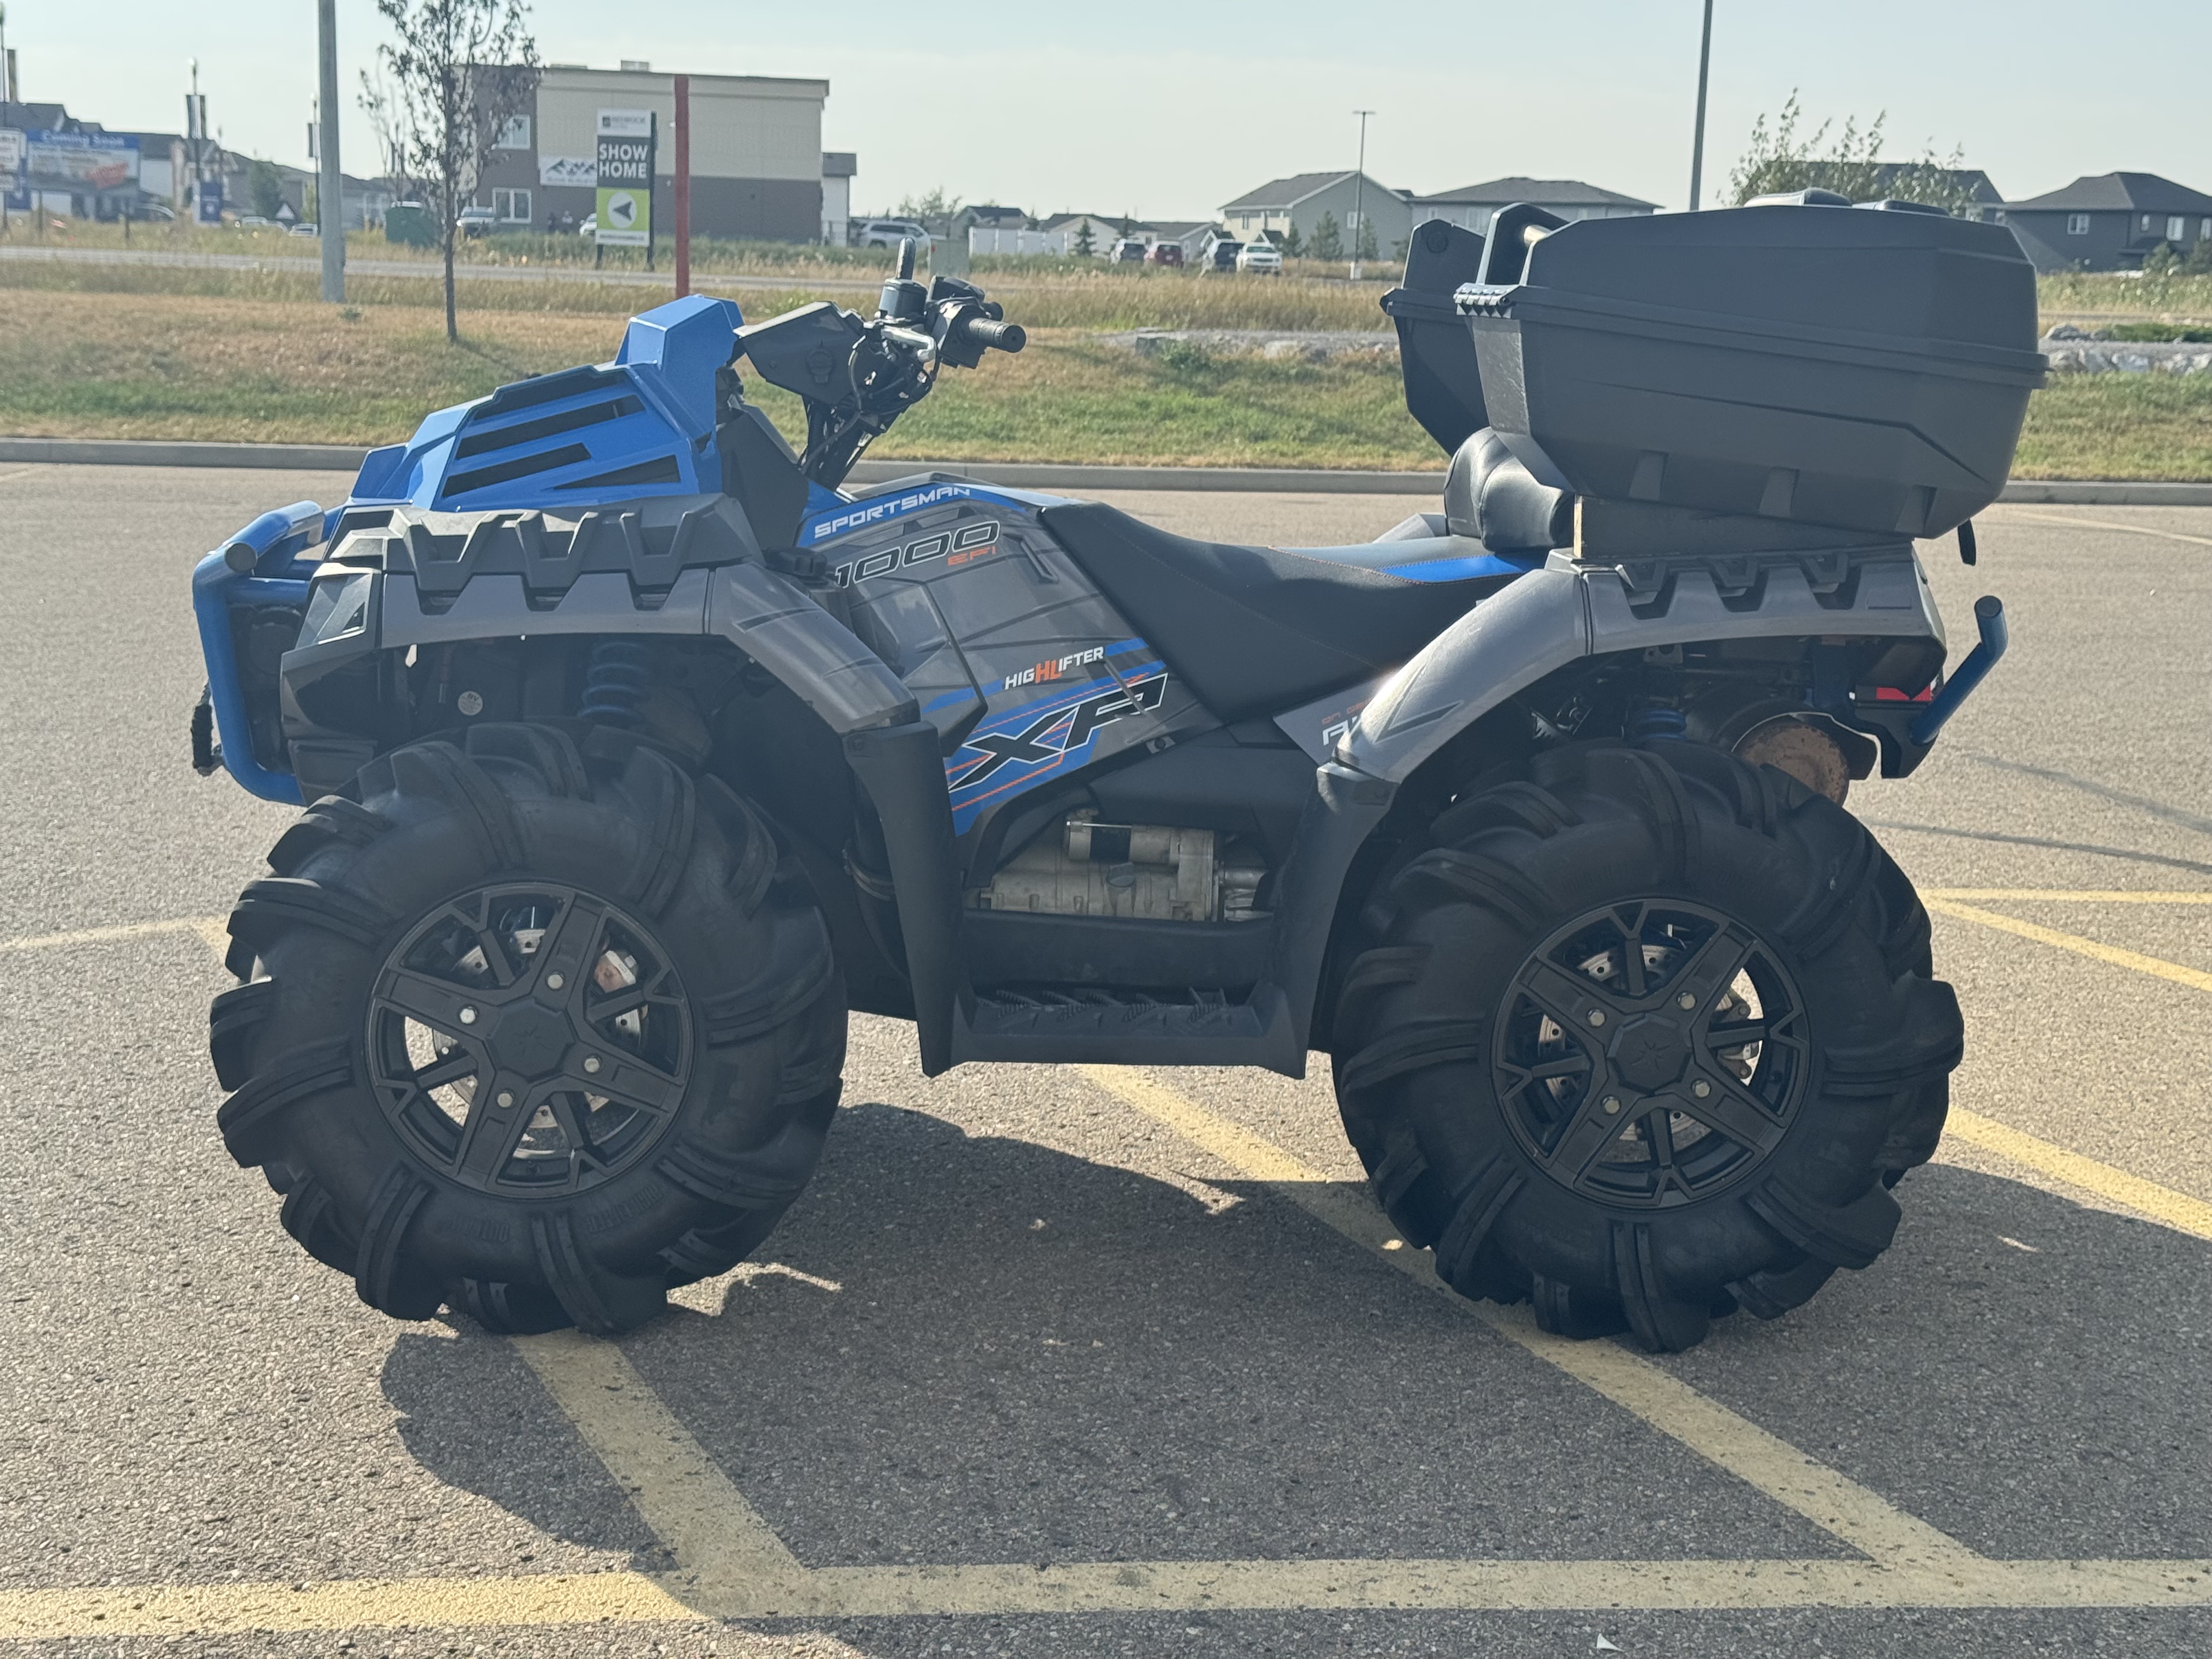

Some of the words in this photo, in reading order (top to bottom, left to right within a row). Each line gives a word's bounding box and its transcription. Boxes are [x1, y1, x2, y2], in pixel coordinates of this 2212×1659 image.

[599, 143, 648, 161] SHOW
[599, 160, 647, 179] HOME
[814, 487, 970, 539] SPORTSMAN
[834, 520, 1001, 589] 1000
[947, 545, 997, 566] EFI
[1005, 646, 1104, 690] HIGHLIFTER
[947, 672, 1169, 794] XP
